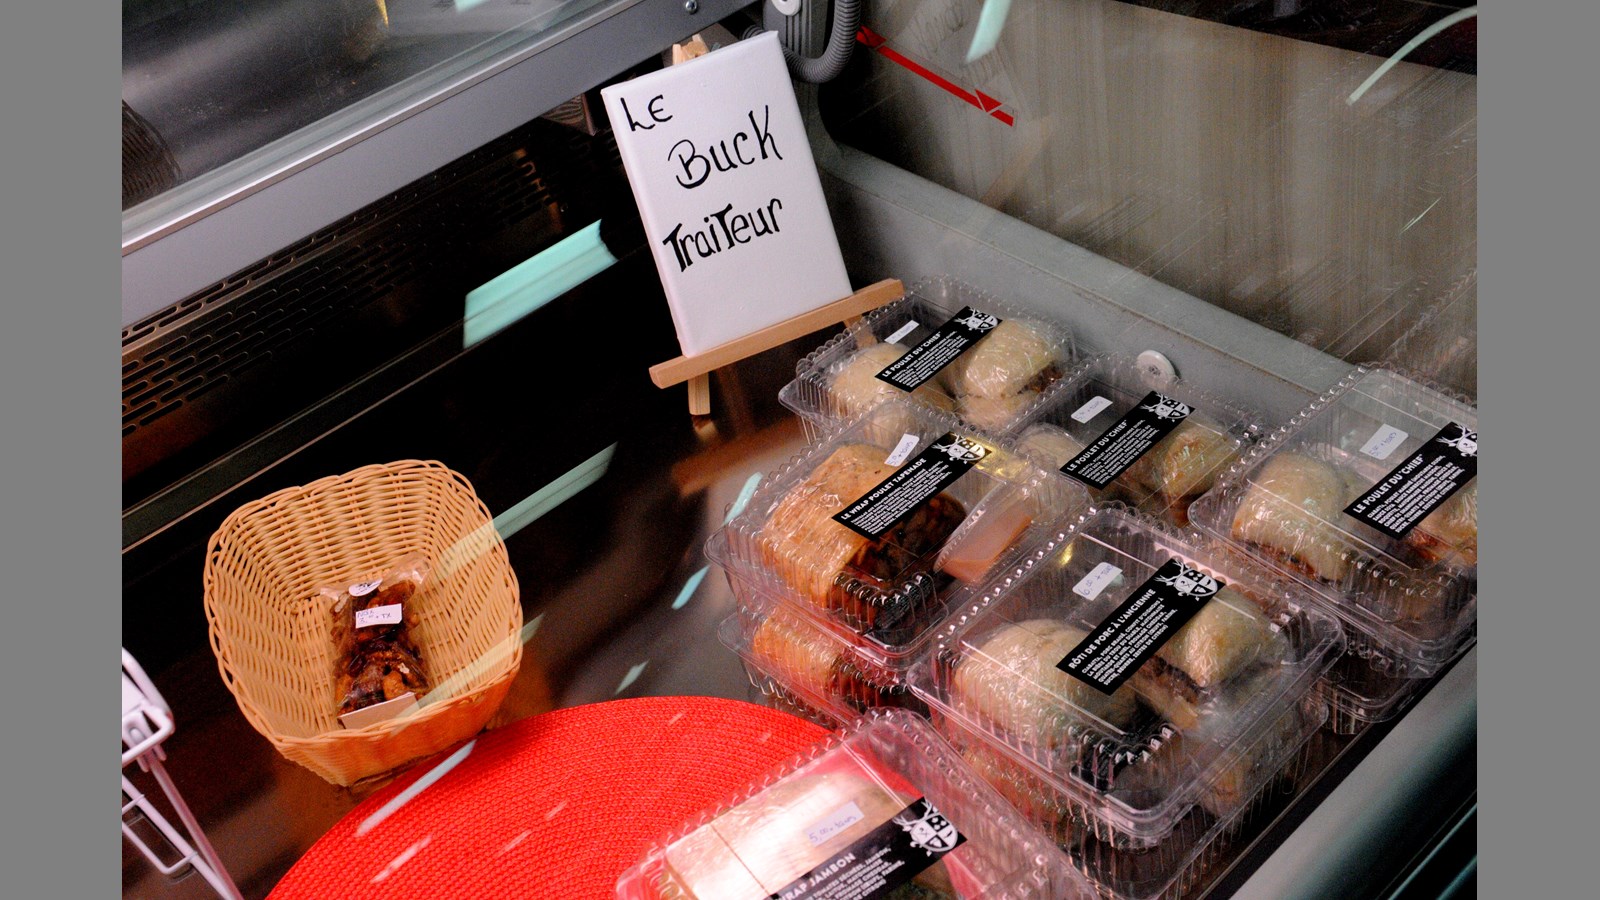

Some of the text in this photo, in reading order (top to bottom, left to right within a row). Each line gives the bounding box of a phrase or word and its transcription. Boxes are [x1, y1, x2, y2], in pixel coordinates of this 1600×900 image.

[620, 94, 674, 132] LE
[882, 369, 892, 378] LE
[889, 353, 914, 372] POULET
[912, 346, 924, 355] DU
[1066, 463, 1078, 471] LE
[1075, 444, 1100, 465] POULET
[1097, 436, 1110, 446] DU
[840, 458, 927, 520] LE WRAP POULET TAPENADE
[1352, 503, 1367, 514] LE
[1362, 482, 1392, 506] POULET
[1388, 473, 1403, 485] DU
[1068, 652, 1088, 669] RÔTI
[1084, 643, 1098, 655] DE
[1094, 626, 1115, 645] PORC
[1117, 588, 1156, 624] L'ANCIENNE
[1128, 627, 1148, 646] FROMAGE
[1128, 647, 1136, 655] AU
[1133, 634, 1150, 649] CITRON
[1145, 638, 1154, 646] DE
[1100, 645, 1113, 657] PORC
[1102, 654, 1111, 662] DU
[809, 852, 856, 887] JAMBON
